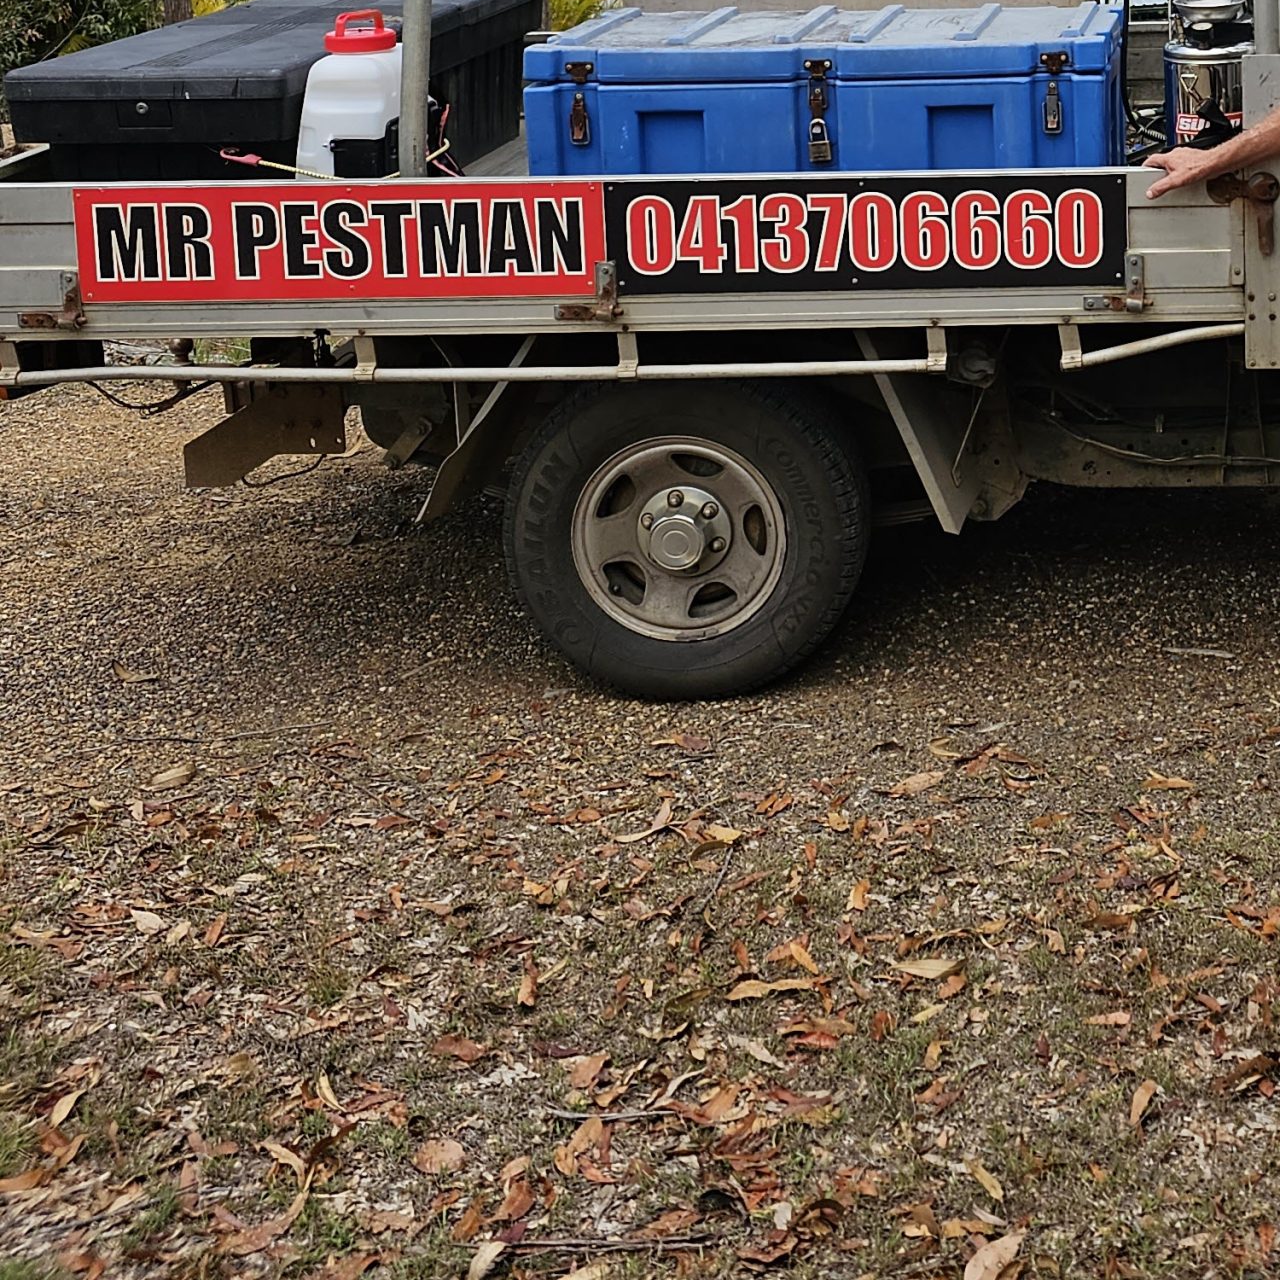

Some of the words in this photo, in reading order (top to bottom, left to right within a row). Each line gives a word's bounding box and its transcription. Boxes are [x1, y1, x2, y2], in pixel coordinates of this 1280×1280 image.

[93, 202, 215, 282] MR
[231, 197, 586, 281] PESTMAN
[626, 188, 1104, 276] 0413706660
